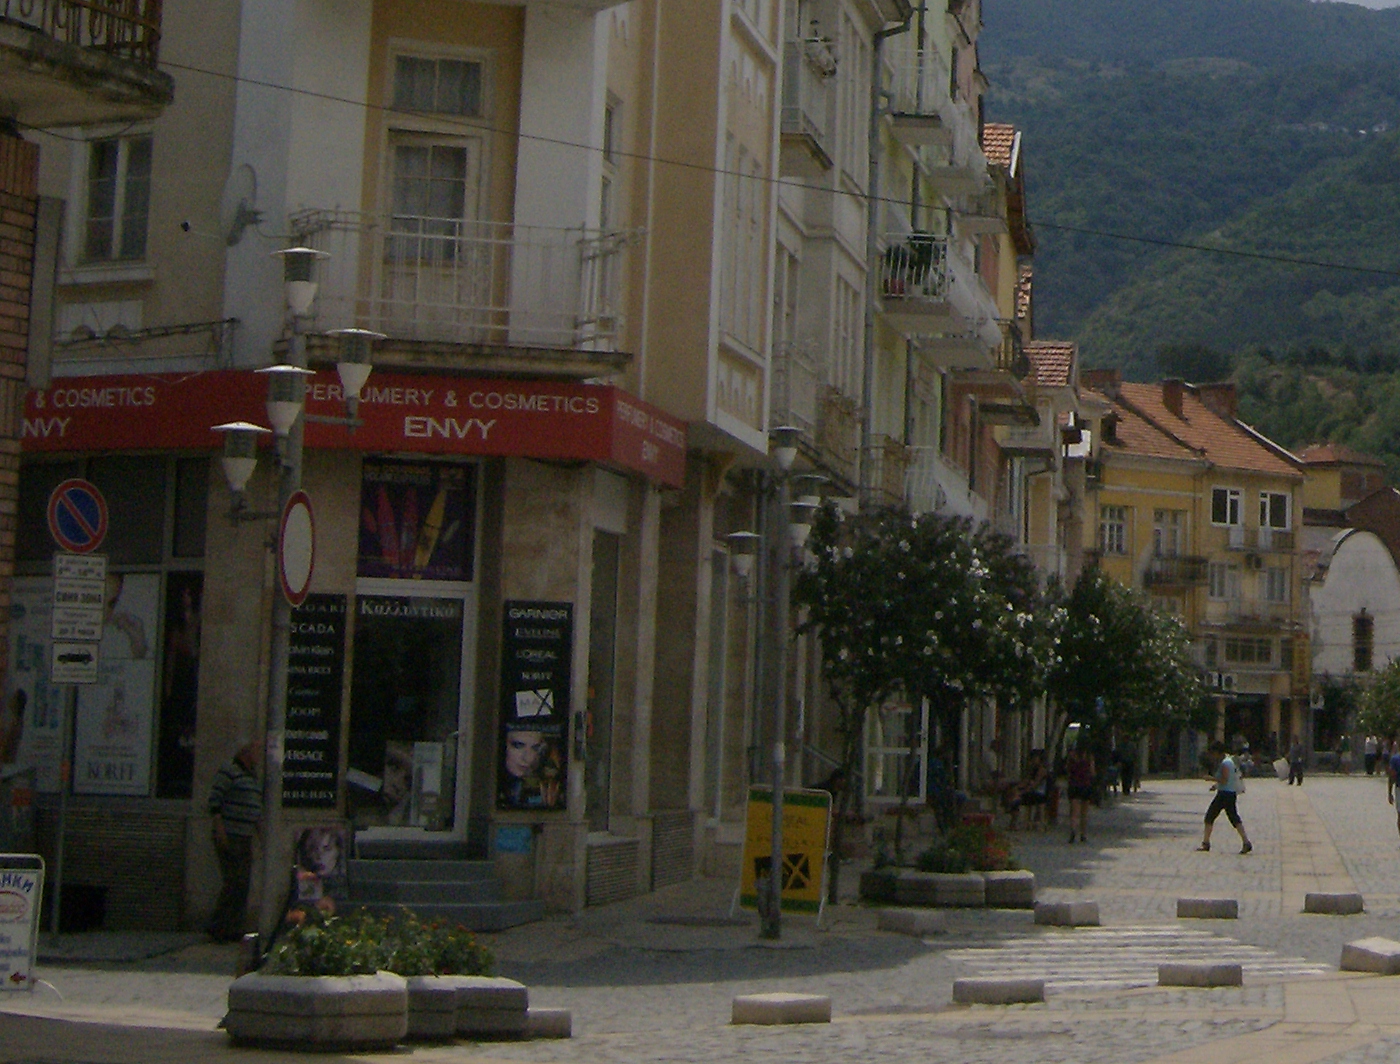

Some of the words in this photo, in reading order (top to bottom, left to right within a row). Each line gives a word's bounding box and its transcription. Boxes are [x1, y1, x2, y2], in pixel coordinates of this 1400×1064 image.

[36, 389, 47, 408] &
[54, 386, 156, 408] COSMETICS
[304, 383, 434, 406] PERUMERY
[444, 390, 459, 408] &
[468, 390, 600, 414] COSMETICS
[22, 416, 72, 438] NVY
[404, 416, 497, 440] ENVY
[509, 608, 568, 620] GARNIER
[289, 623, 336, 634] SCADA
